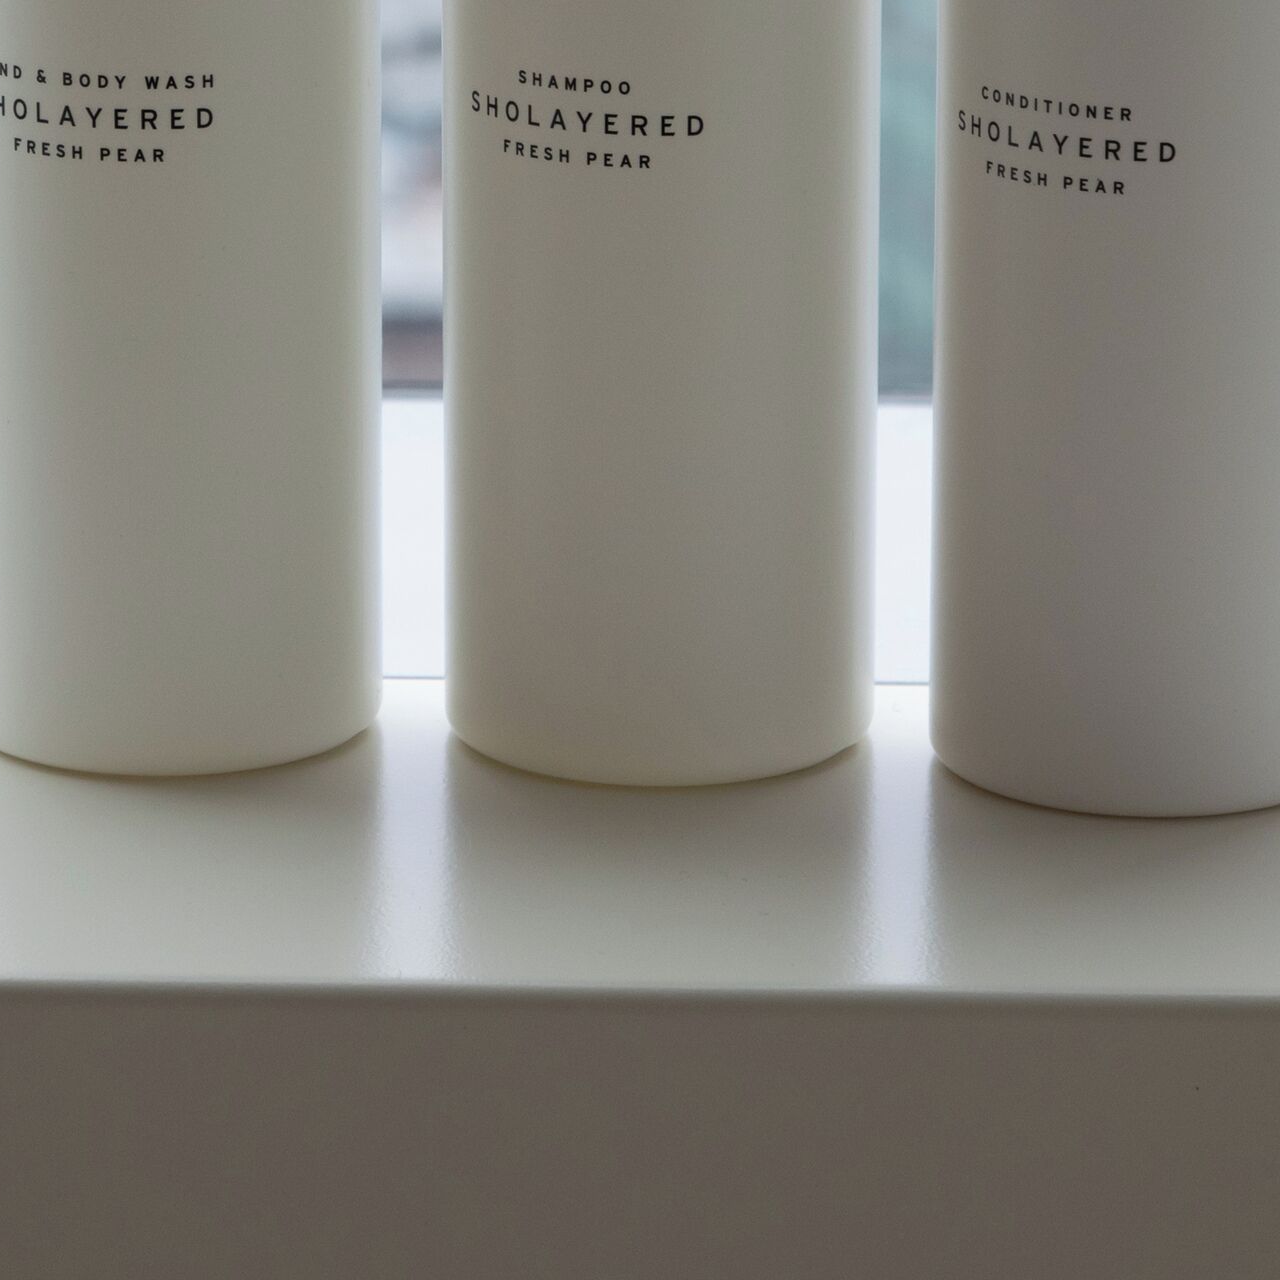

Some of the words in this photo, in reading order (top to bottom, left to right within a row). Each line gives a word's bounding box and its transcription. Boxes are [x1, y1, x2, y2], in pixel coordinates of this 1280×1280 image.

[36, 69, 47, 84] &
[62, 72, 126, 90] BODY
[144, 74, 215, 90] WASH
[518, 70, 631, 95] SHAMPOO
[472, 90, 704, 136] SHOLAYERED
[981, 86, 1132, 121] CONDITIONER
[14, 137, 83, 160] FRESH
[99, 147, 165, 162] PEAR
[958, 110, 1176, 162] SHOLAYERED
[503, 139, 570, 163] FRESH
[586, 152, 651, 169] PEAR
[985, 161, 1048, 186] FRESH
[1062, 176, 1125, 195] PEAR
